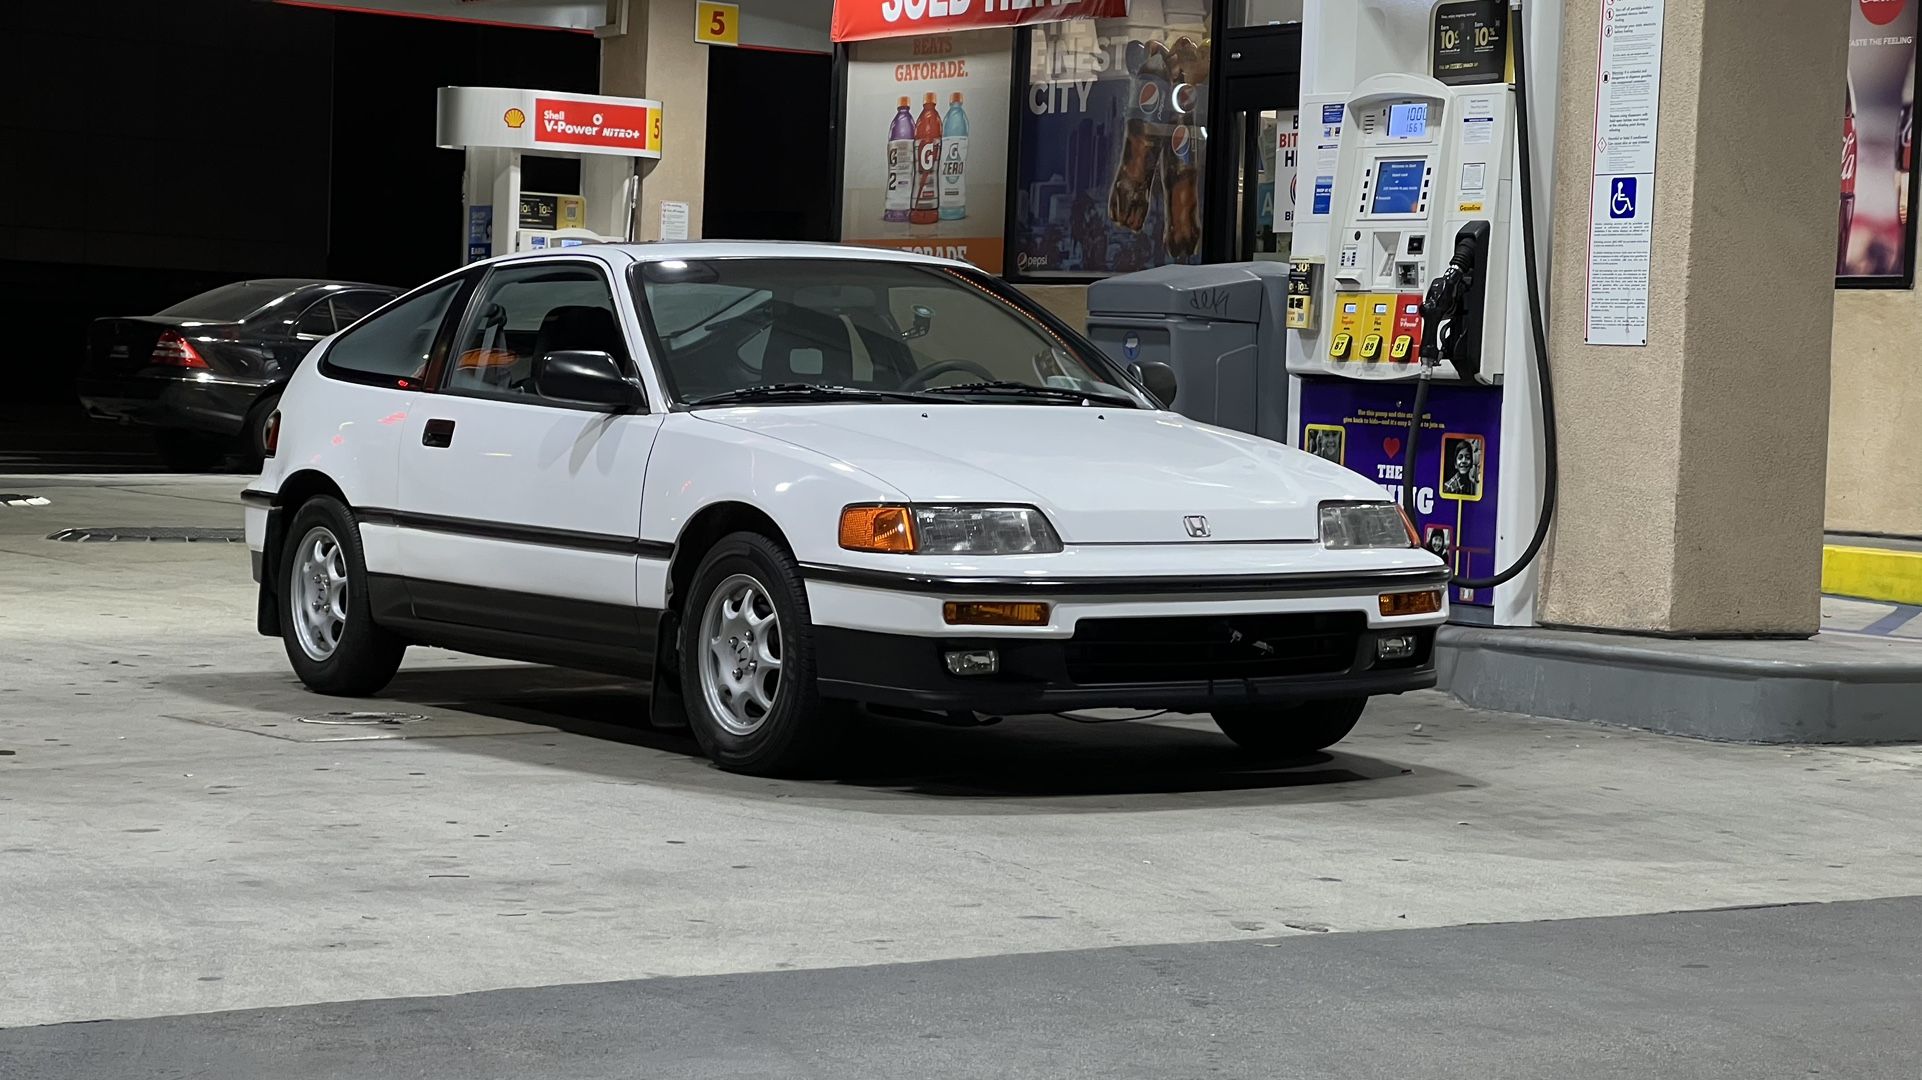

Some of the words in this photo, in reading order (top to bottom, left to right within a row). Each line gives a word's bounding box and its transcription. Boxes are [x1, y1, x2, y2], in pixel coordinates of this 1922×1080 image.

[710, 11, 726, 35] 5
[1849, 38, 1868, 46] ASTE
[1884, 36, 1912, 45] FEELING
[895, 60, 968, 82] GATORADE.
[1029, 81, 1093, 115] CITY
[544, 110, 565, 120] Shell
[544, 120, 598, 135] V-Power
[654, 118, 660, 139] 5
[920, 143, 934, 170] G
[950, 143, 959, 160] G
[943, 162, 963, 175] ZERO
[889, 173, 896, 190] 2
[1028, 254, 1048, 268] pepsi
[1377, 464, 1403, 479] THE
